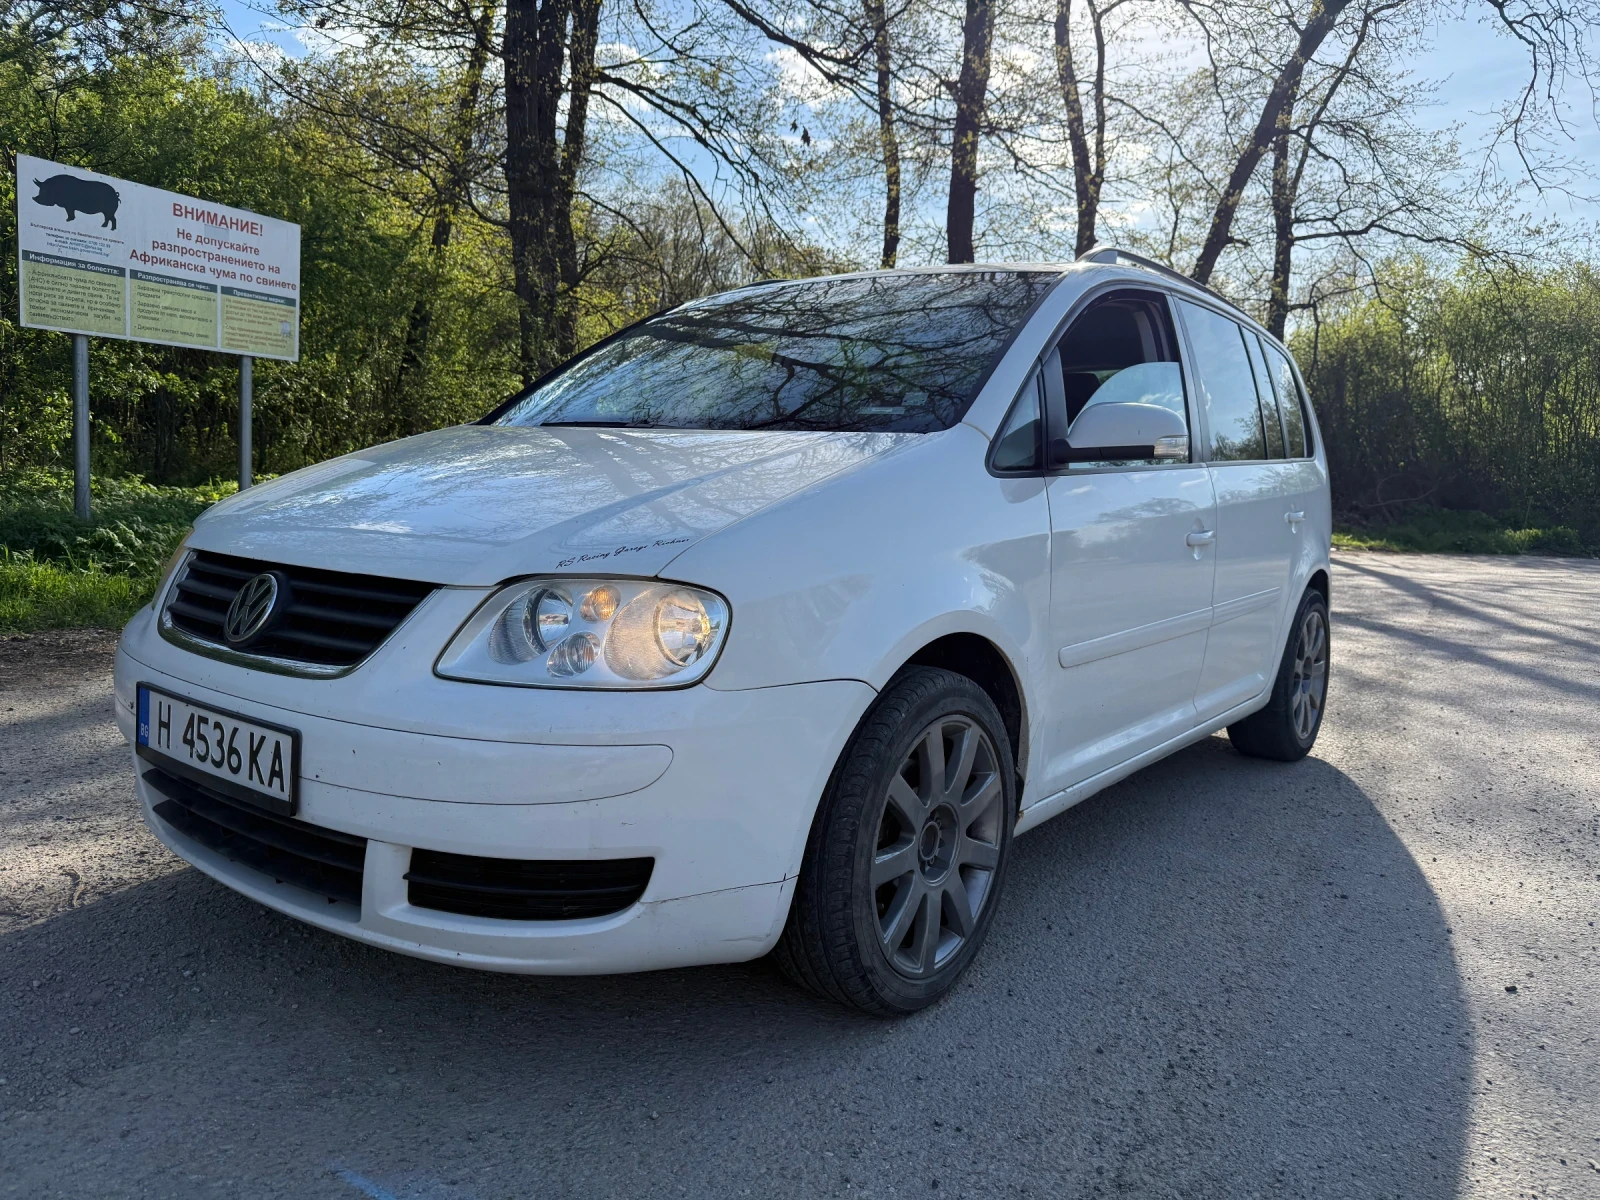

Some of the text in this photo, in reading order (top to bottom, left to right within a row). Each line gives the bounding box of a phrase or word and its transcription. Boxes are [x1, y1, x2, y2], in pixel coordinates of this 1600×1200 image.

[172, 202, 263, 237] ВНИМАНИЕ!
[152, 239, 280, 274] разпространението на
[176, 227, 259, 257] Не допускайте
[29, 253, 76, 267] Информация
[87, 263, 119, 274] болестта:
[129, 248, 296, 291] Африканска чума по свинете
[555, 557, 576, 569] RS
[140, 723, 149, 738] BG
[183, 712, 242, 775] 4536
[248, 732, 285, 792] KA
